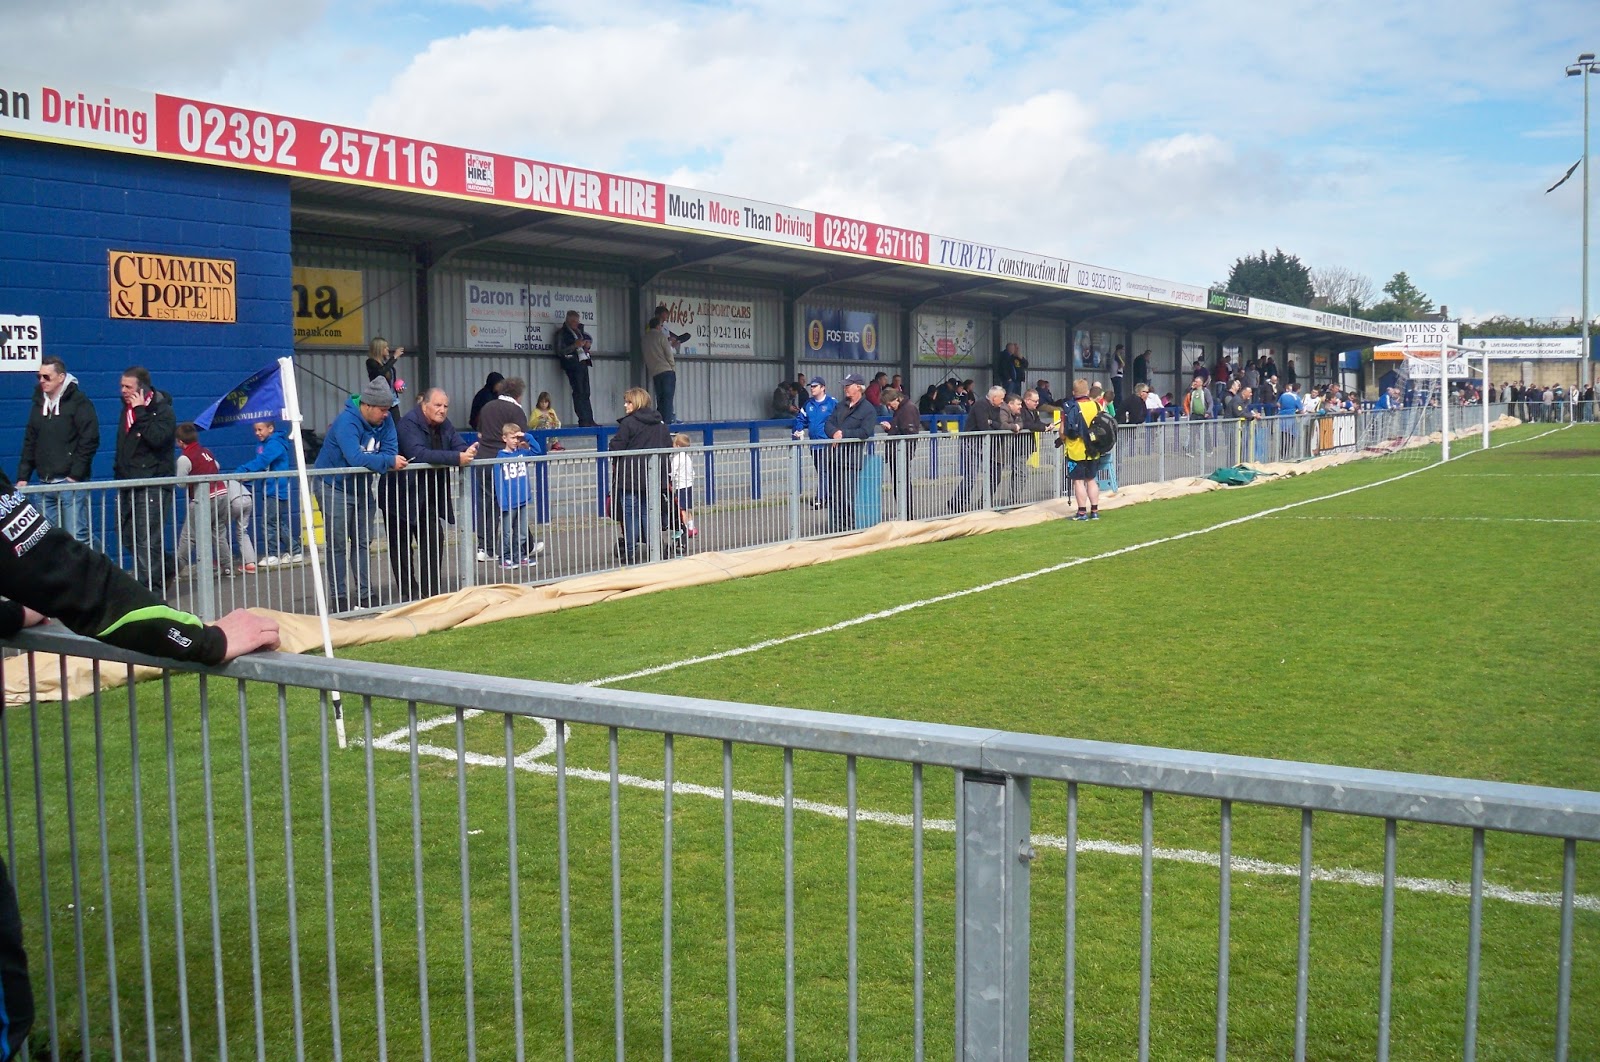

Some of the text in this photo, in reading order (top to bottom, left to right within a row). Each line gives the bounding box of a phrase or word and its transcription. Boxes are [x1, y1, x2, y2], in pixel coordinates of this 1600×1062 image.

[42, 87, 147, 145] Driving
[179, 104, 439, 187] 02392 257116
[467, 166, 487, 181] HIRE
[514, 162, 656, 219] DRIVER HIRE
[669, 193, 812, 243] Much More Than Driving
[823, 217, 923, 262] 02392 257116
[114, 255, 233, 288] CUMMINS
[940, 239, 997, 272] TURVEY
[998, 257, 1055, 284] construction
[1057, 261, 1070, 284] ltd
[1077, 270, 1089, 286] 023
[1091, 272, 1107, 289] 9225
[115, 282, 234, 321] & POPE LTD.
[469, 285, 593, 308] Daron Ford daron.co.uk
[156, 308, 208, 319] EST. 1969
[554, 309, 565, 319] 023
[581, 311, 594, 320] 7612
[660, 299, 751, 326] Mike's AIRPORT CARS
[480, 326, 508, 336] Motability
[525, 325, 541, 333] YOUR
[696, 325, 751, 340] 023 9242 1164
[1423, 334, 1444, 344] LTD
[1441, 324, 1449, 333] &
[16, 519, 52, 556] BRIDGEST
